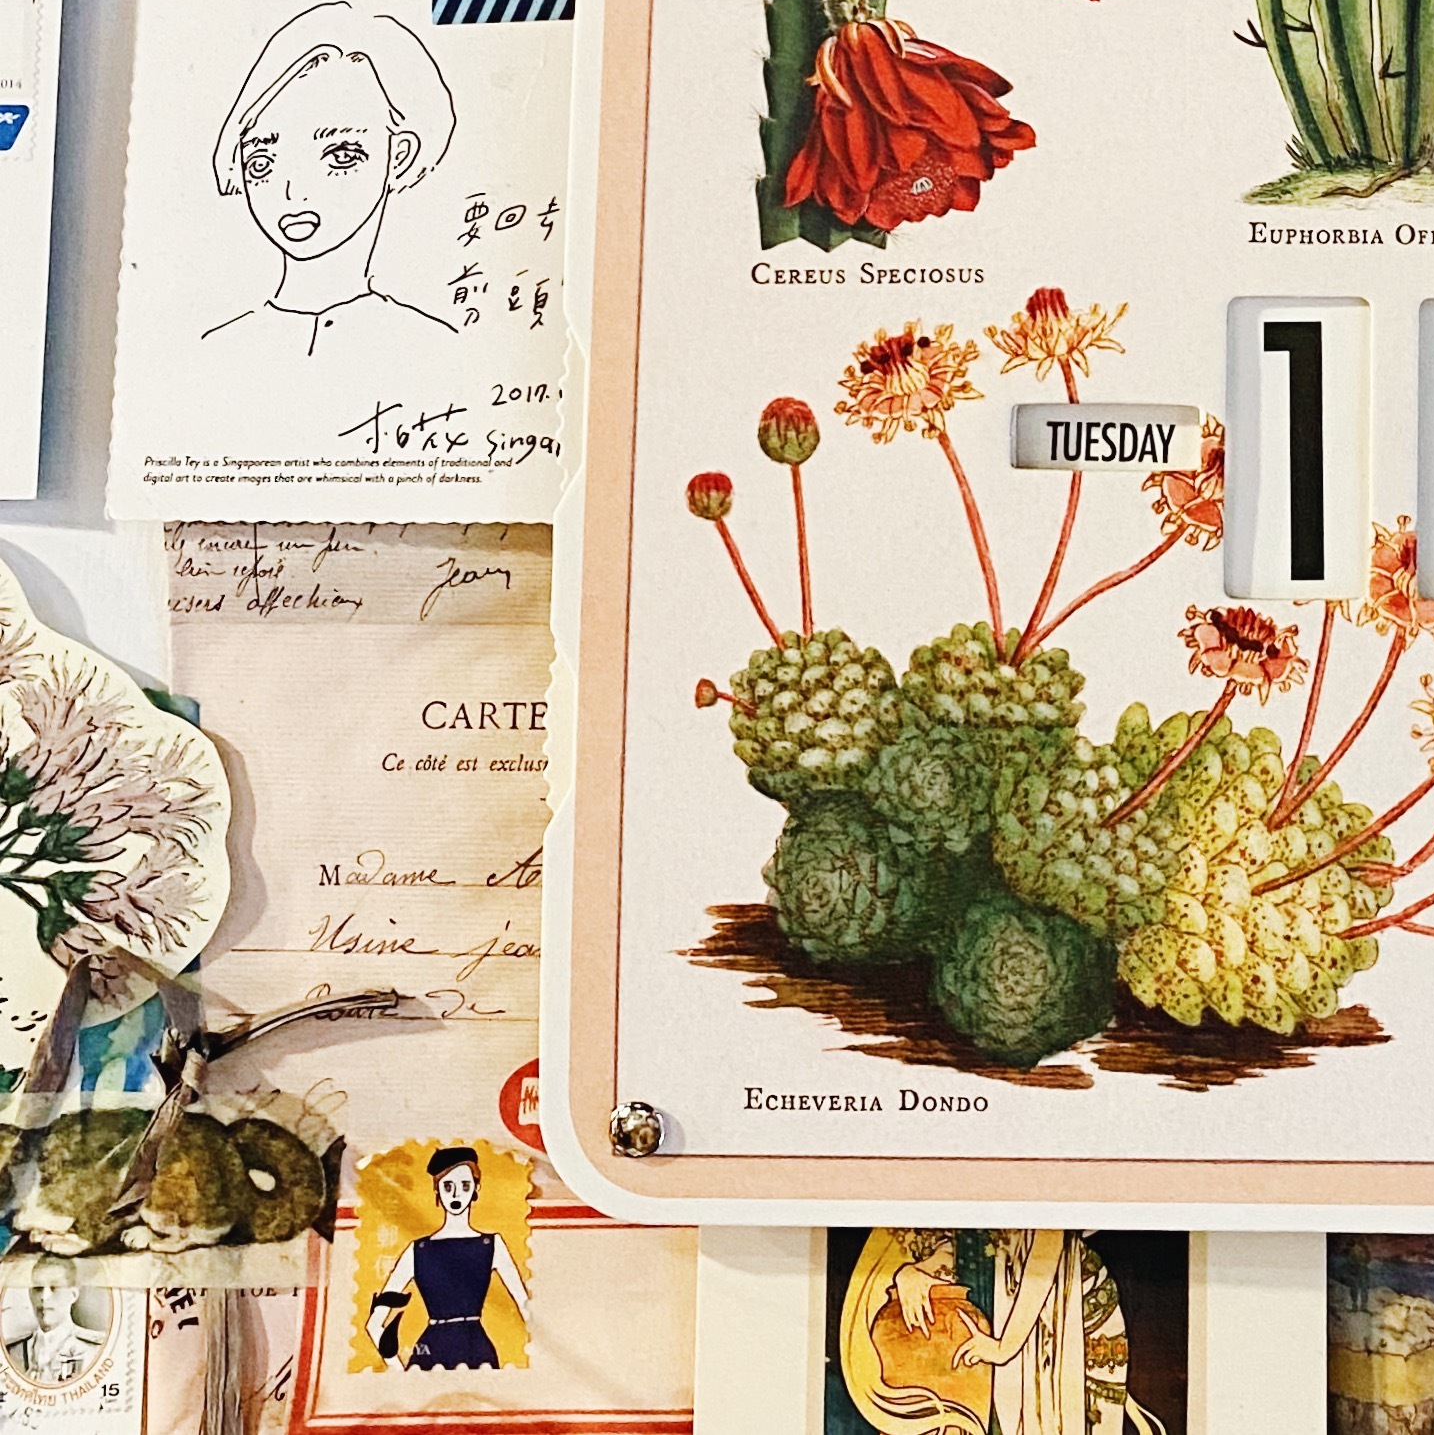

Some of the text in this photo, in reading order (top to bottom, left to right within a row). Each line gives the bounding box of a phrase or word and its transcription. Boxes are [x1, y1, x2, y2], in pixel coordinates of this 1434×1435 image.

[1248, 222, 1384, 245] EUPHORBIA
[751, 262, 984, 285] CEREUS SPECIOSUS
[1047, 421, 1176, 464] TUESDAY
[145, 456, 181, 467] Priscilla
[185, 456, 199, 470] Tey
[203, 457, 210, 467] is
[223, 456, 281, 470] Singaporean
[285, 457, 309, 467] artist
[313, 457, 332, 467] who
[335, 457, 379, 467] combines
[382, 457, 425, 467] elements
[429, 457, 439, 471] of
[441, 457, 491, 468] traditional
[494, 458, 512, 468] and
[143, 472, 173, 485] digital
[175, 474, 189, 483] art
[193, 474, 202, 483] to
[205, 474, 235, 483] create
[238, 474, 271, 485] images
[274, 473, 294, 483] that
[297, 475, 312, 483] are
[316, 473, 362, 483] whimsical
[365, 473, 384, 483] with
[396, 473, 423, 486] pinch
[426, 473, 437, 486] of
[439, 473, 483, 483] darkness.
[422, 700, 548, 731] CARTE
[382, 753, 405, 771] Ce
[416, 754, 448, 771] côté
[457, 757, 478, 771] est
[744, 1087, 988, 1112] ECHEVERIA DONDO
[61, 1357, 114, 1404] THAILAND
[101, 1383, 120, 1397] 15
